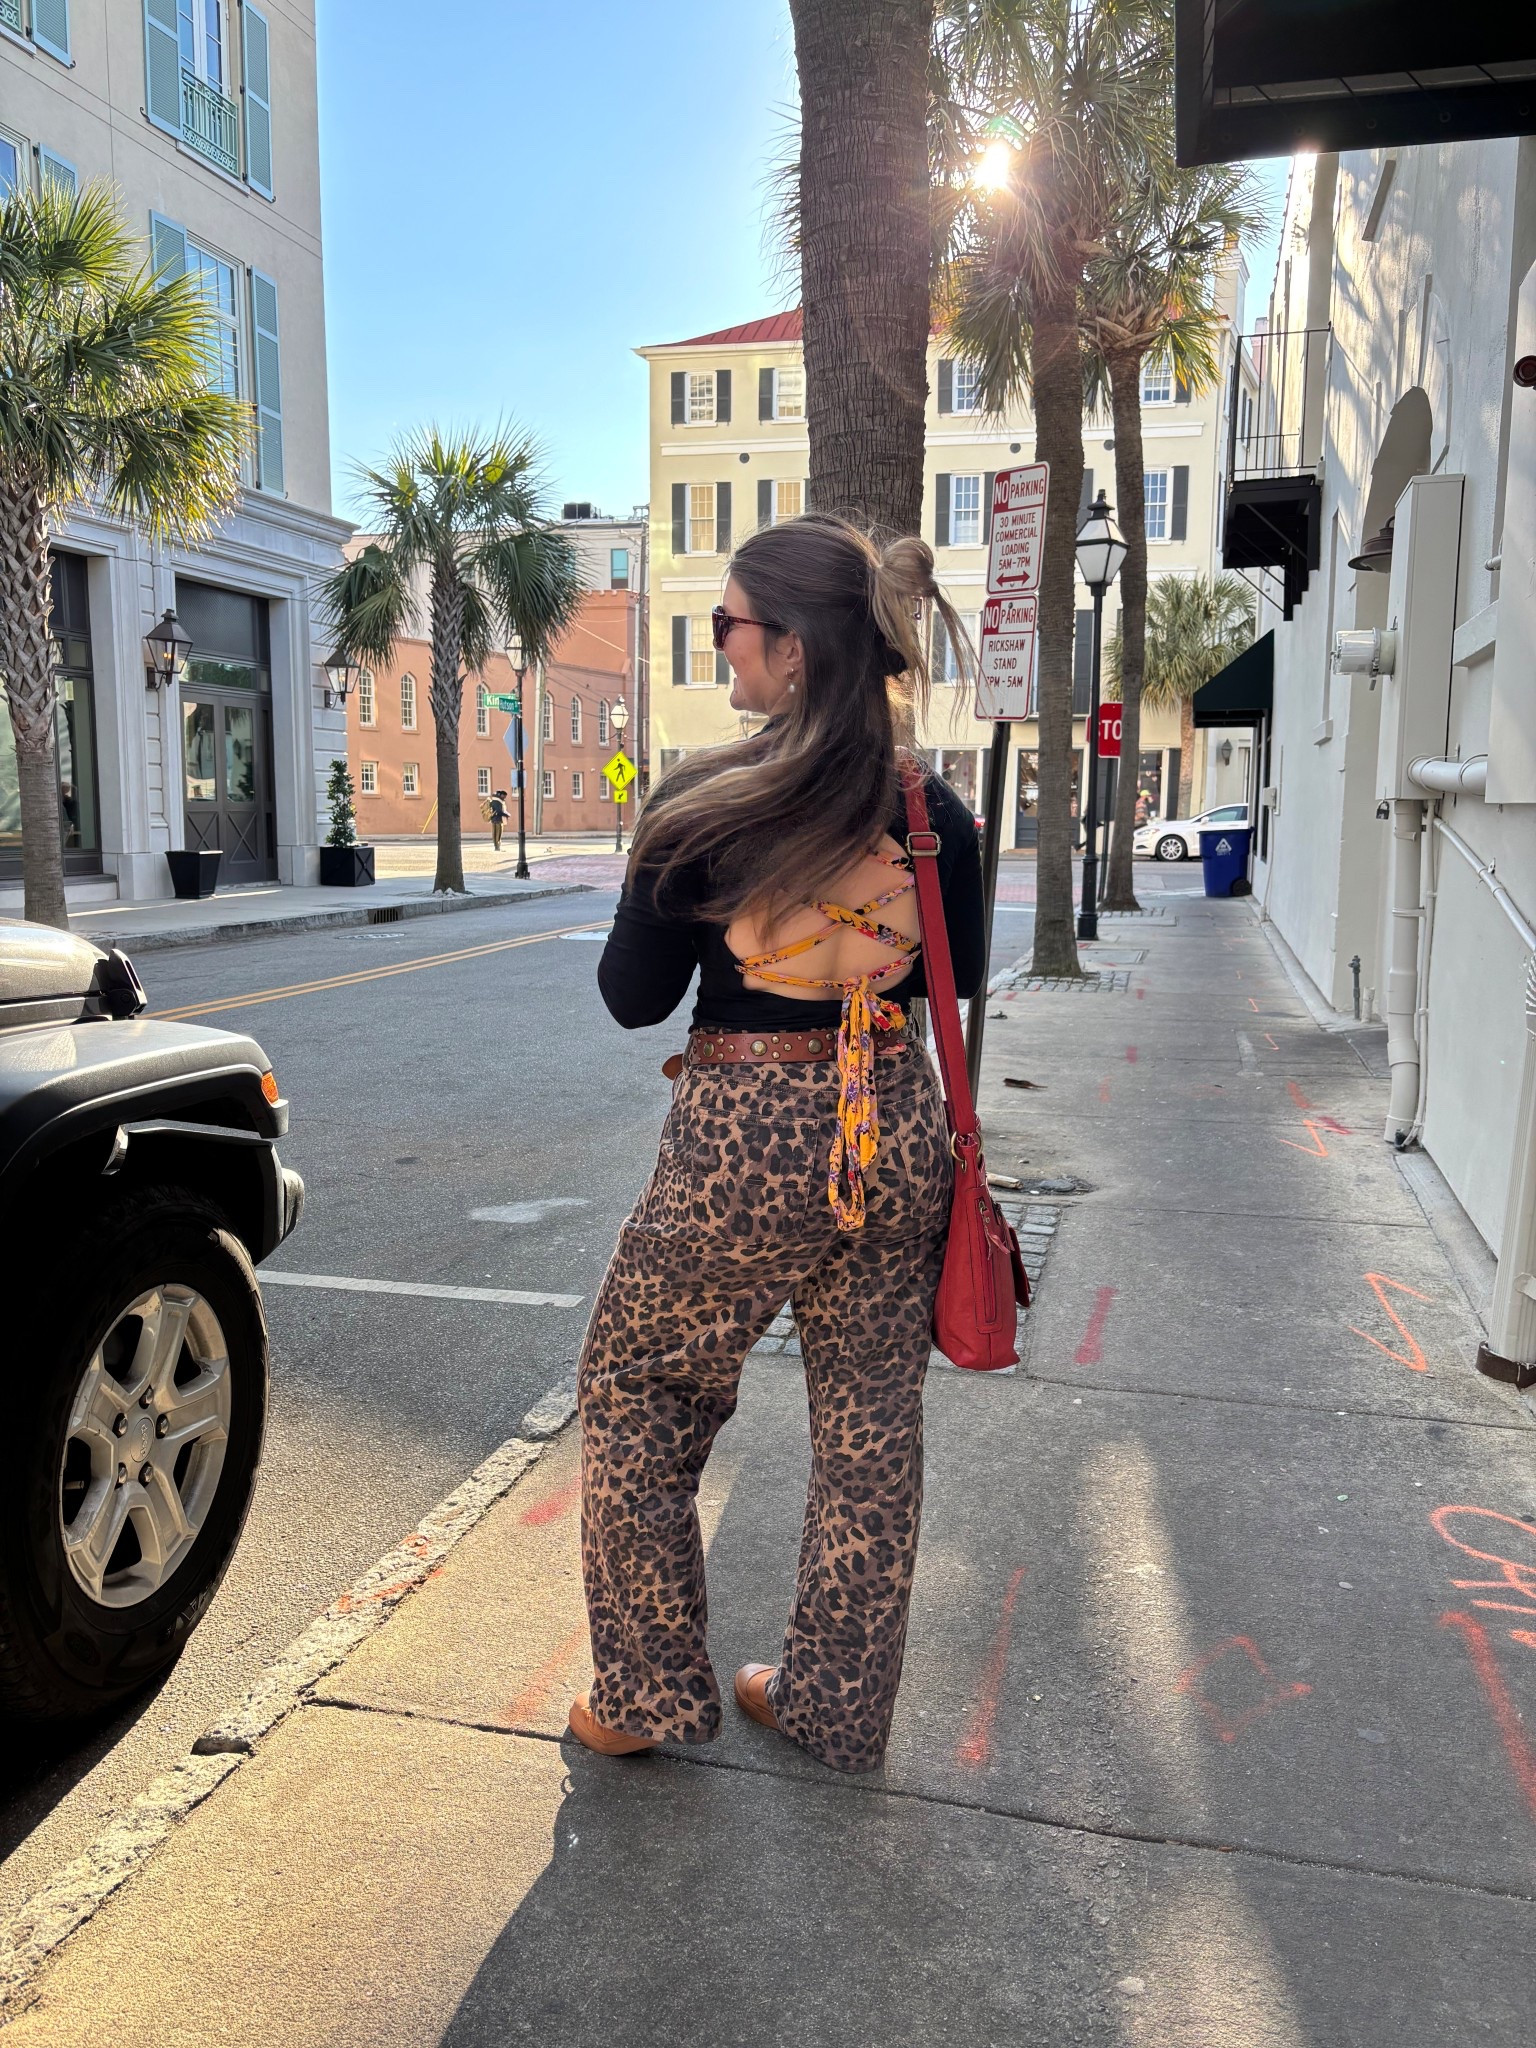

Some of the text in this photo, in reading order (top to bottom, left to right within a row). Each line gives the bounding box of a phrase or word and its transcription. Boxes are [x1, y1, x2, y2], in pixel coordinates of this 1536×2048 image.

[995, 478, 1044, 505] NO PARKING
[1000, 512, 1036, 528] 30 MINUTE
[995, 527, 1037, 543] COMMERCIAL
[1002, 541, 1030, 556] LOADING
[984, 606, 1034, 629] NO PARKING
[989, 639, 1026, 652] RICKSHAW
[993, 657, 1017, 670] STAND
[486, 695, 499, 706] Kin
[1098, 719, 1122, 741] TO
